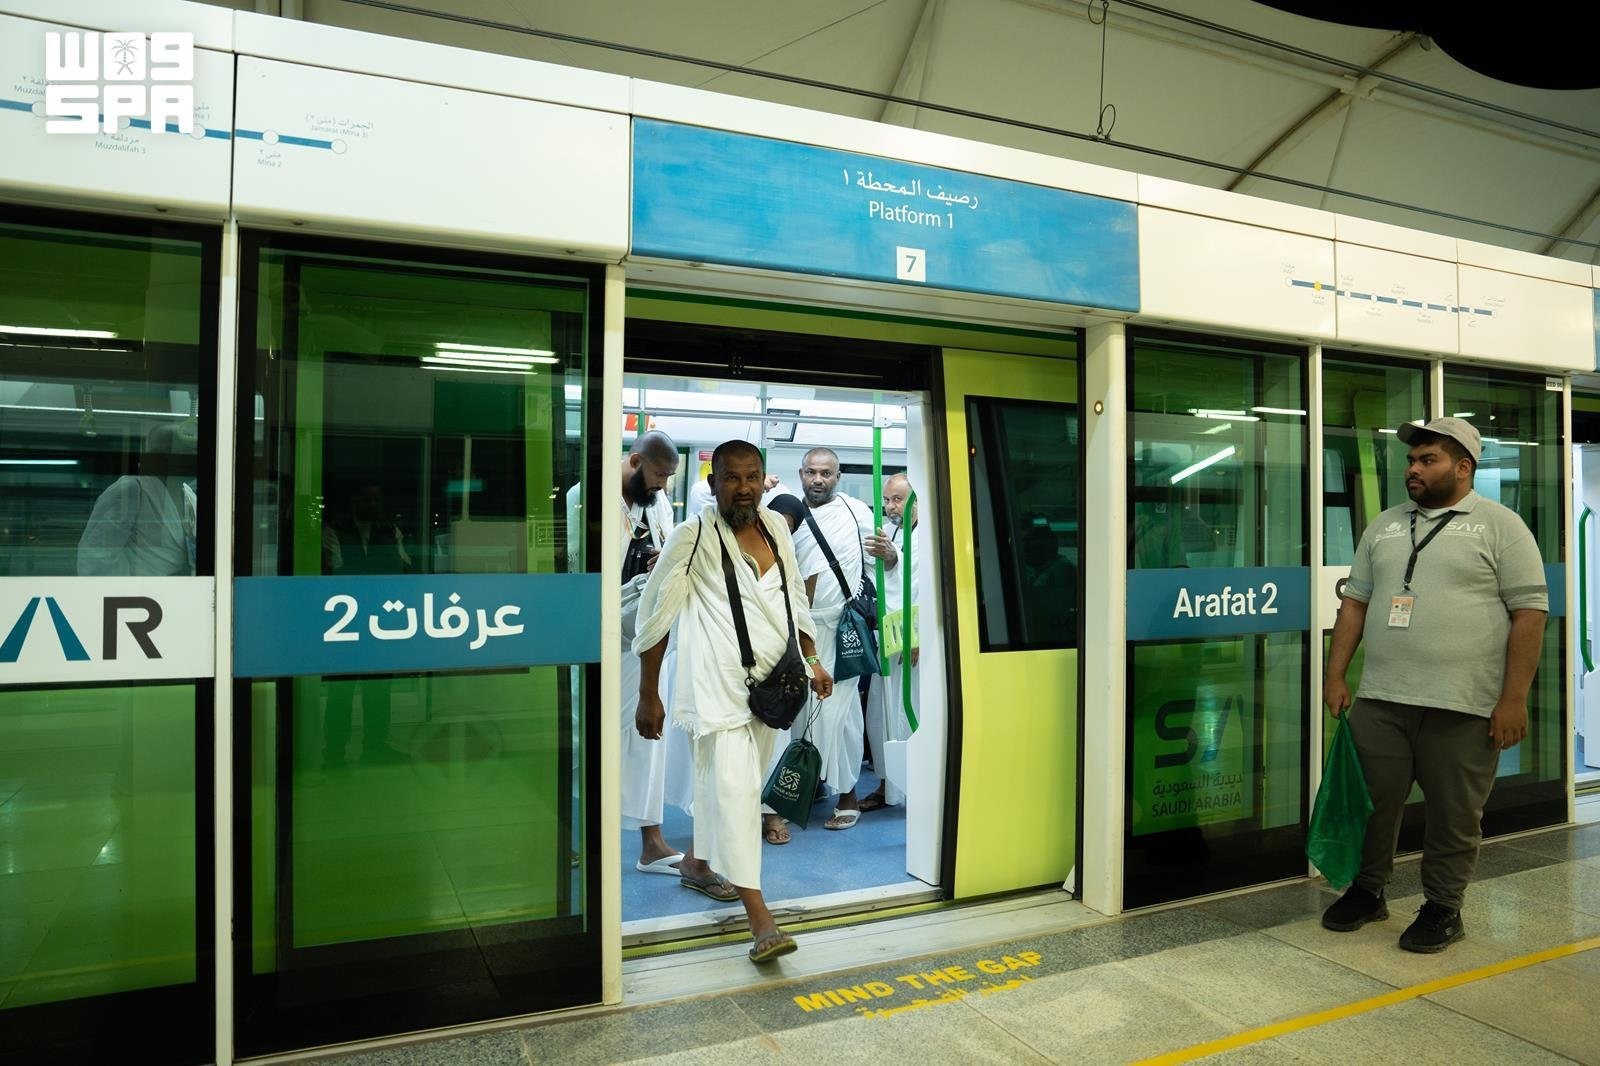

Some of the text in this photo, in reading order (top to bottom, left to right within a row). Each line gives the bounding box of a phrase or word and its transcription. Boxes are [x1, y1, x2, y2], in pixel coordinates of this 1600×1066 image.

[95, 141, 140, 153] Muzdalifah
[256, 158, 276, 168] Mina
[856, 171, 921, 197] المحطة
[927, 185, 979, 210] رصيف
[869, 201, 953, 229] Platform 1
[905, 255, 917, 273] 7
[1446, 521, 1486, 533] SAR
[1172, 582, 1278, 618] Arafat 2
[323, 592, 525, 650] عرفات 2
[1152, 775, 1210, 798] السعودية
[1152, 792, 1242, 818] SAUDI ARABIA
[793, 951, 1042, 1013] MIND THE GAP
